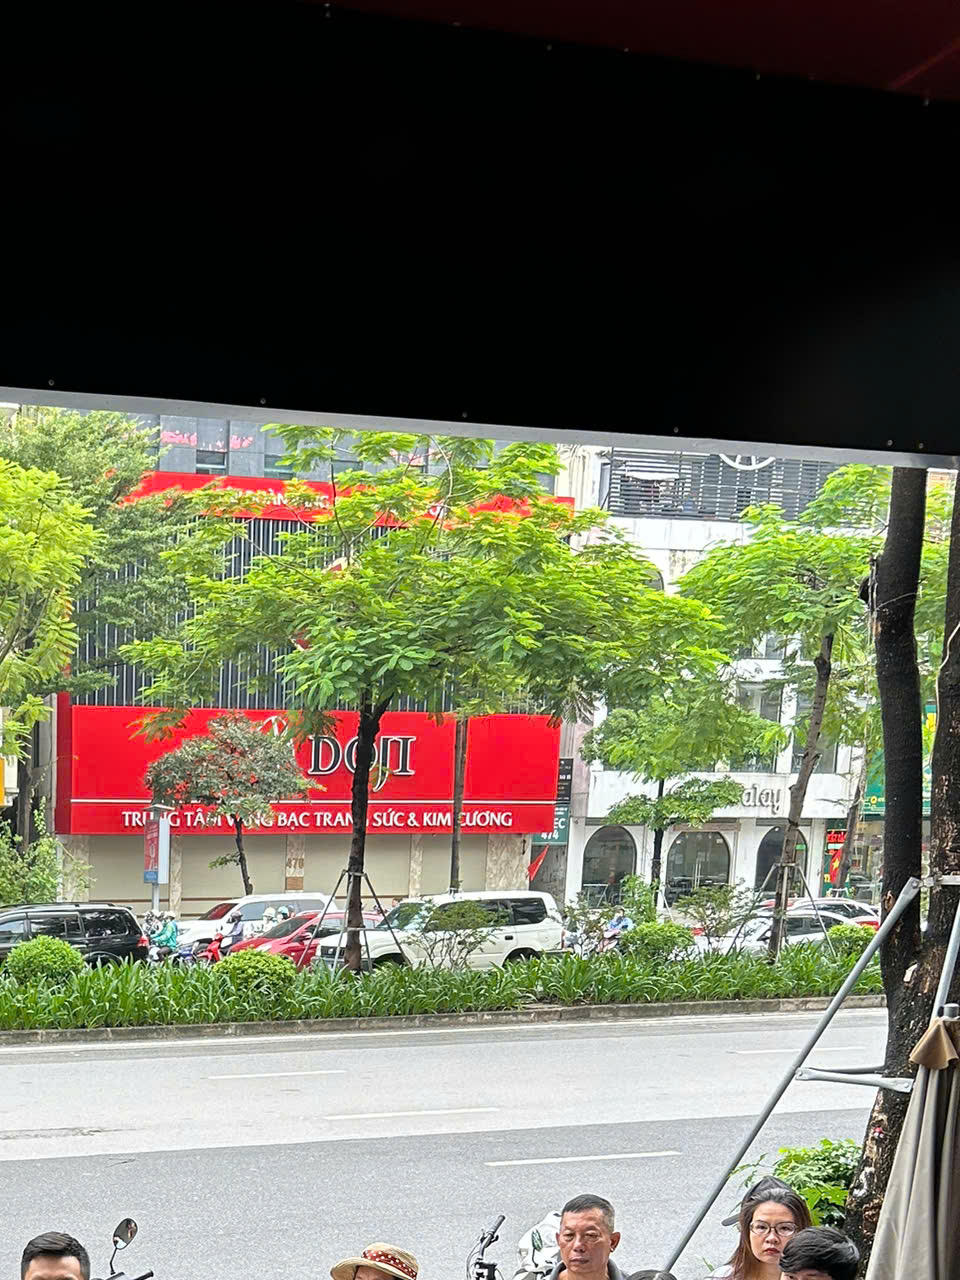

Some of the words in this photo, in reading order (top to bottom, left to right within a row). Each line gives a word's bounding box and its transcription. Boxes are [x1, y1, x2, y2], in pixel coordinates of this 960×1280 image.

[278, 811, 310, 831] BẠC
[314, 811, 369, 827] TRAN
[372, 808, 405, 827] SỨC
[407, 812, 420, 827] &
[423, 812, 451, 826] KIM
